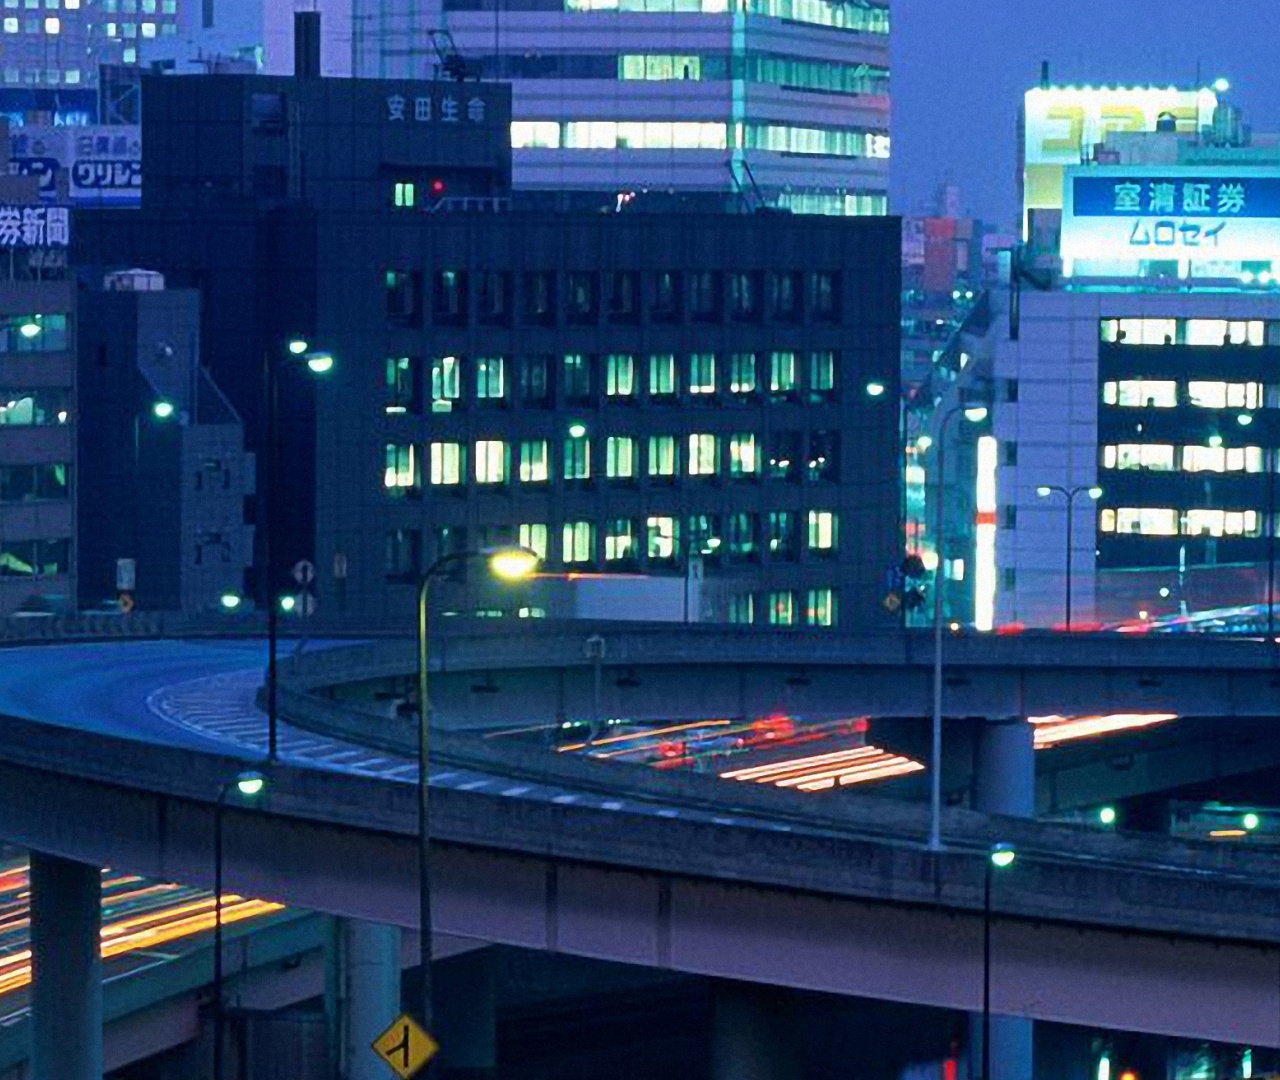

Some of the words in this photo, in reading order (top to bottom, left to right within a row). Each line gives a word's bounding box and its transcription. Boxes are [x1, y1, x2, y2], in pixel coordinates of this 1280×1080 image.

[386, 95, 486, 121] 安田生命
[1114, 182, 1245, 212] 室清証券
[1129, 219, 1226, 246] ムロセイ
